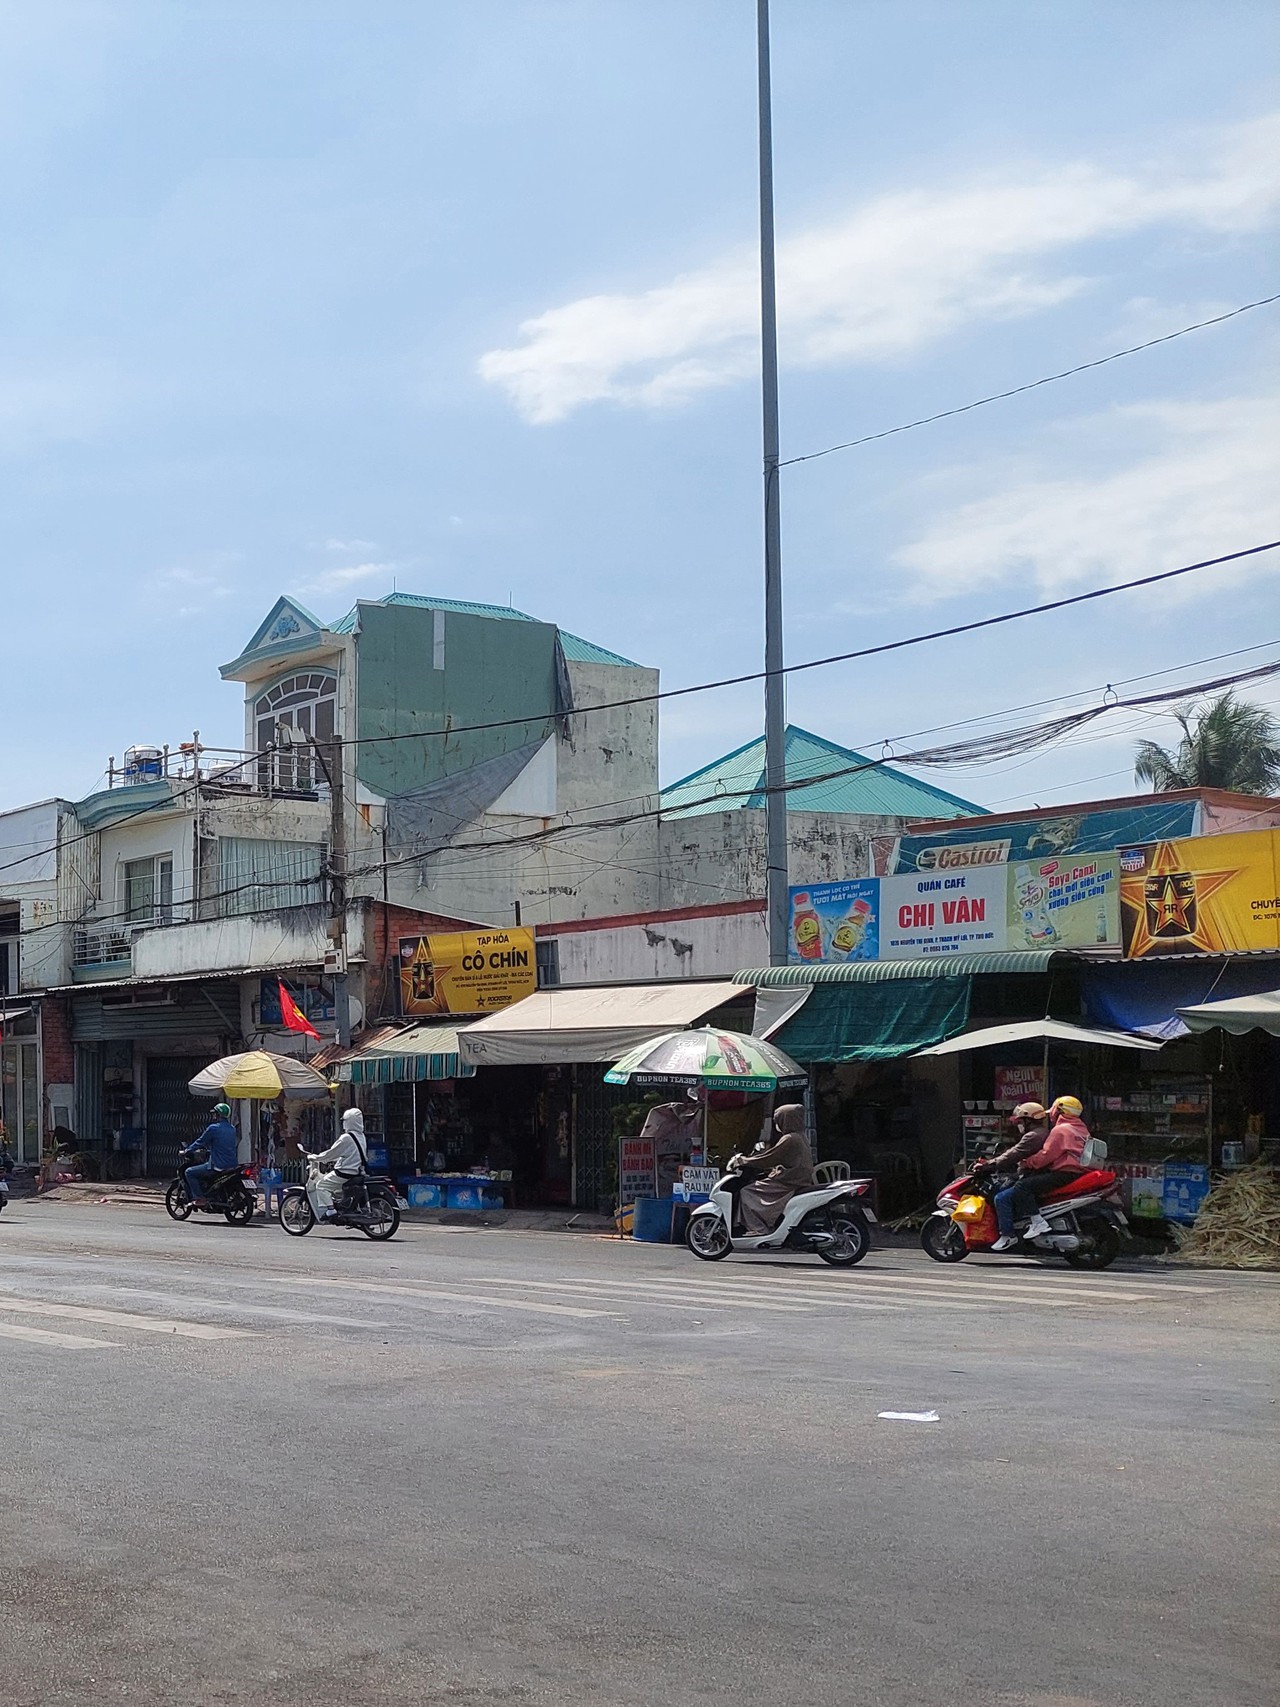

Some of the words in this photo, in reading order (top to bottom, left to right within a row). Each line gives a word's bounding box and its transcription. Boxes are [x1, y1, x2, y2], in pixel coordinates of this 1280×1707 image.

[938, 843, 1004, 869] Castrol
[918, 878, 942, 892] QUÁN
[944, 876, 966, 889] CAFÉ
[1048, 873, 1070, 888] Soya
[898, 902, 935, 930] CHỊ
[942, 896, 985, 924] VÂN
[477, 937, 491, 948] TẠP
[493, 932, 509, 944] HÓA
[462, 950, 485, 971] CÔ
[490, 947, 528, 968] CHÍN
[466, 1043, 487, 1054] TEA
[707, 1079, 740, 1087] BUPNON
[741, 1081, 771, 1089] TEA365
[684, 1170, 701, 1179] CAM
[685, 1183, 701, 1192] RAU
